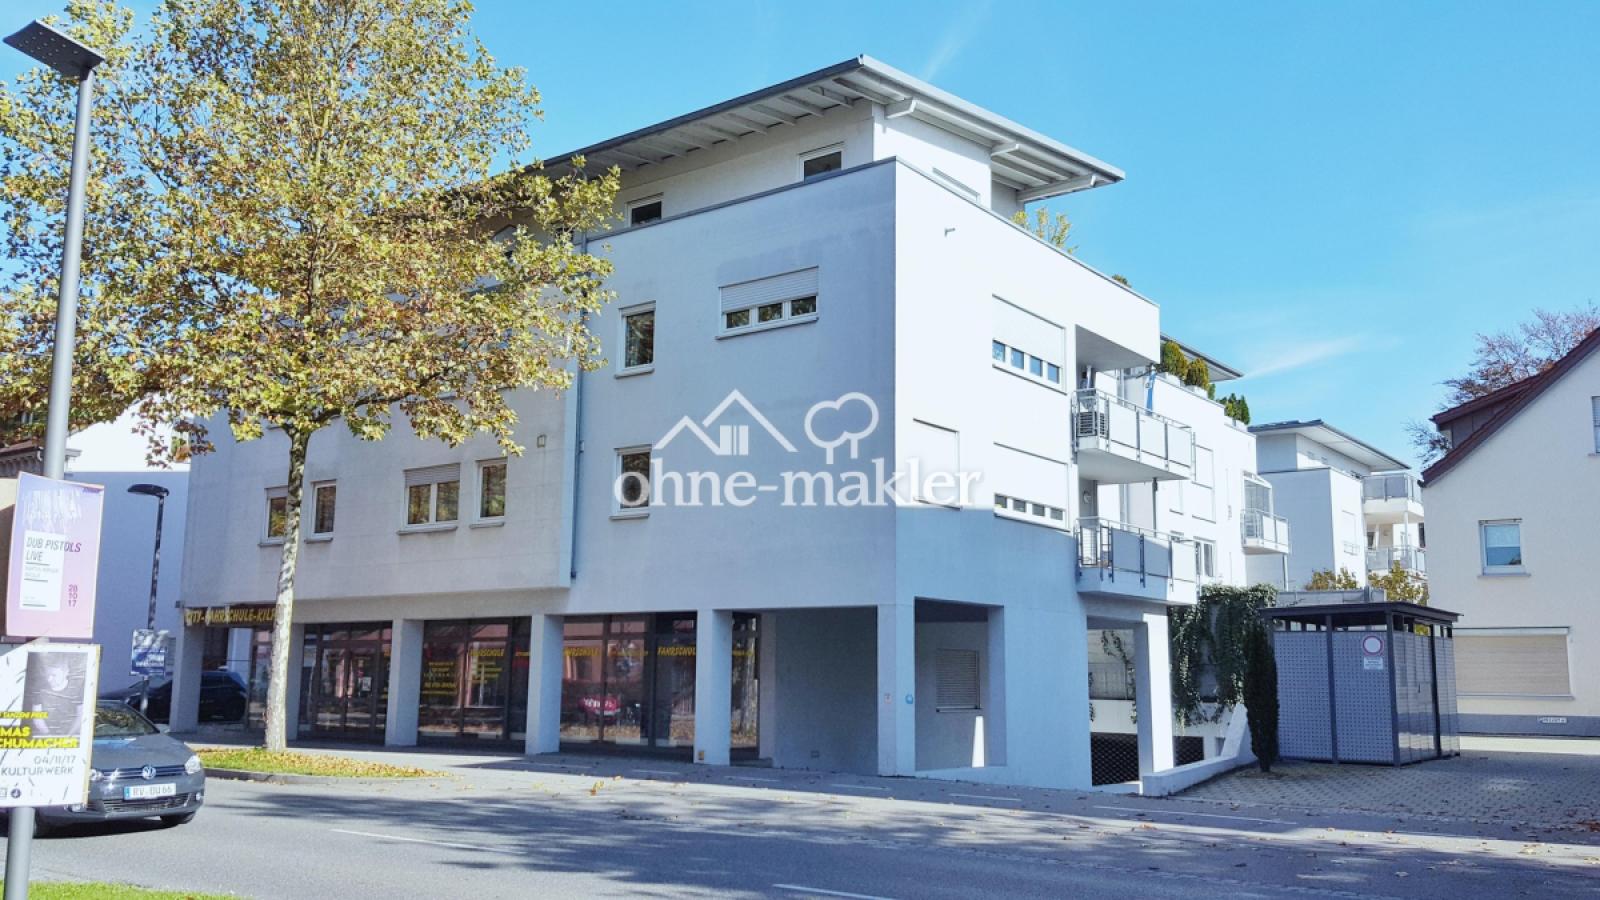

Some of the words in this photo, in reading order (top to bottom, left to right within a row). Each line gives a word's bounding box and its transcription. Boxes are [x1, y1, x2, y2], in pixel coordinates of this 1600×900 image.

[26, 537, 44, 549] DUB
[45, 539, 82, 553] PISTOLS
[26, 550, 43, 562] LIVE
[1, 766, 74, 777] KULTURWERK
